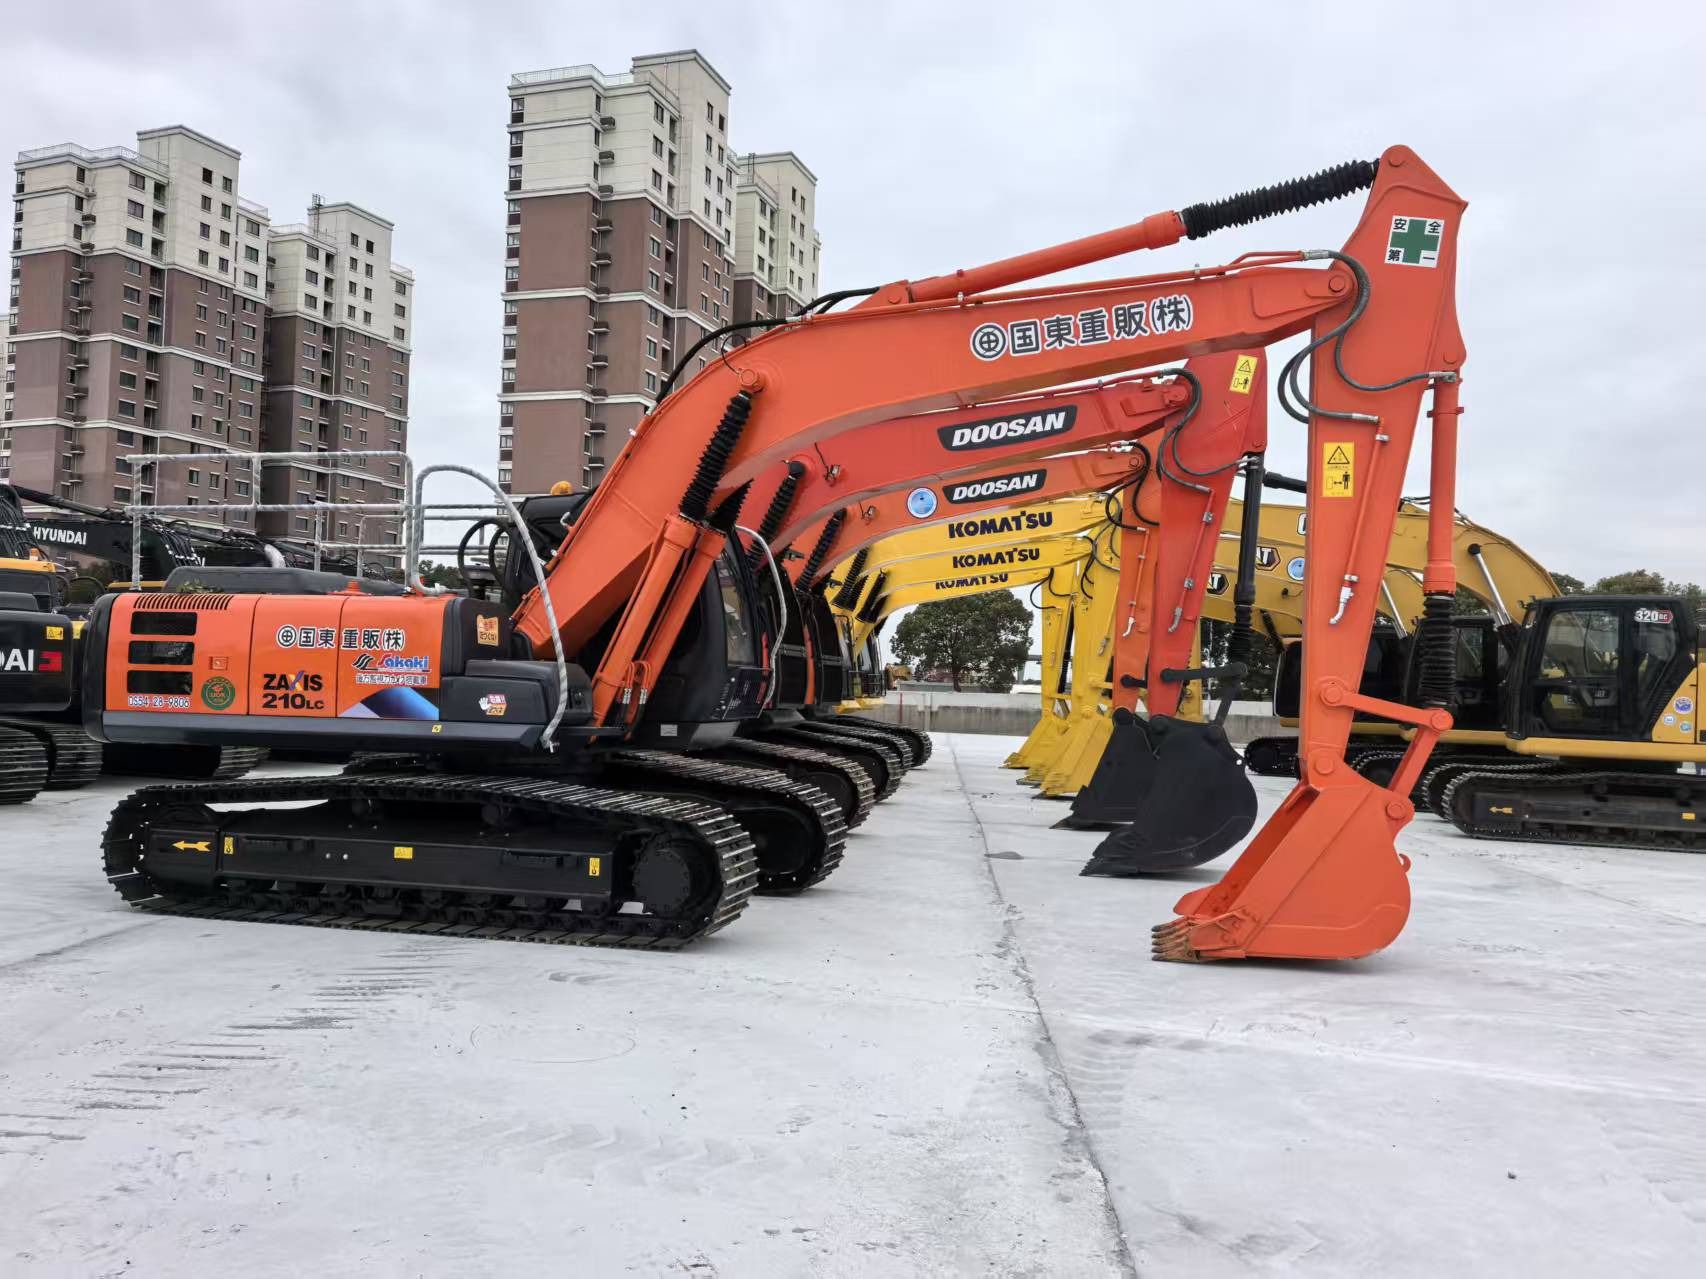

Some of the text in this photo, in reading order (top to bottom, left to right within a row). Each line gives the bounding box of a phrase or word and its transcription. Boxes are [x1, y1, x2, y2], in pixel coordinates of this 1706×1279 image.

[1393, 218, 1442, 234] 安 全
[1387, 249, 1402, 262] 第
[952, 412, 1066, 447] DOOSAN
[953, 474, 1037, 500] DOOSAN
[949, 511, 1053, 538] KOMATSU
[33, 526, 87, 545] HYUNDAI
[953, 548, 1040, 569] KOMATSU
[0, 648, 34, 671] AI
[378, 653, 430, 669] Sakaki
[263, 670, 323, 691] ZAXIS
[262, 693, 325, 710] 210LC
